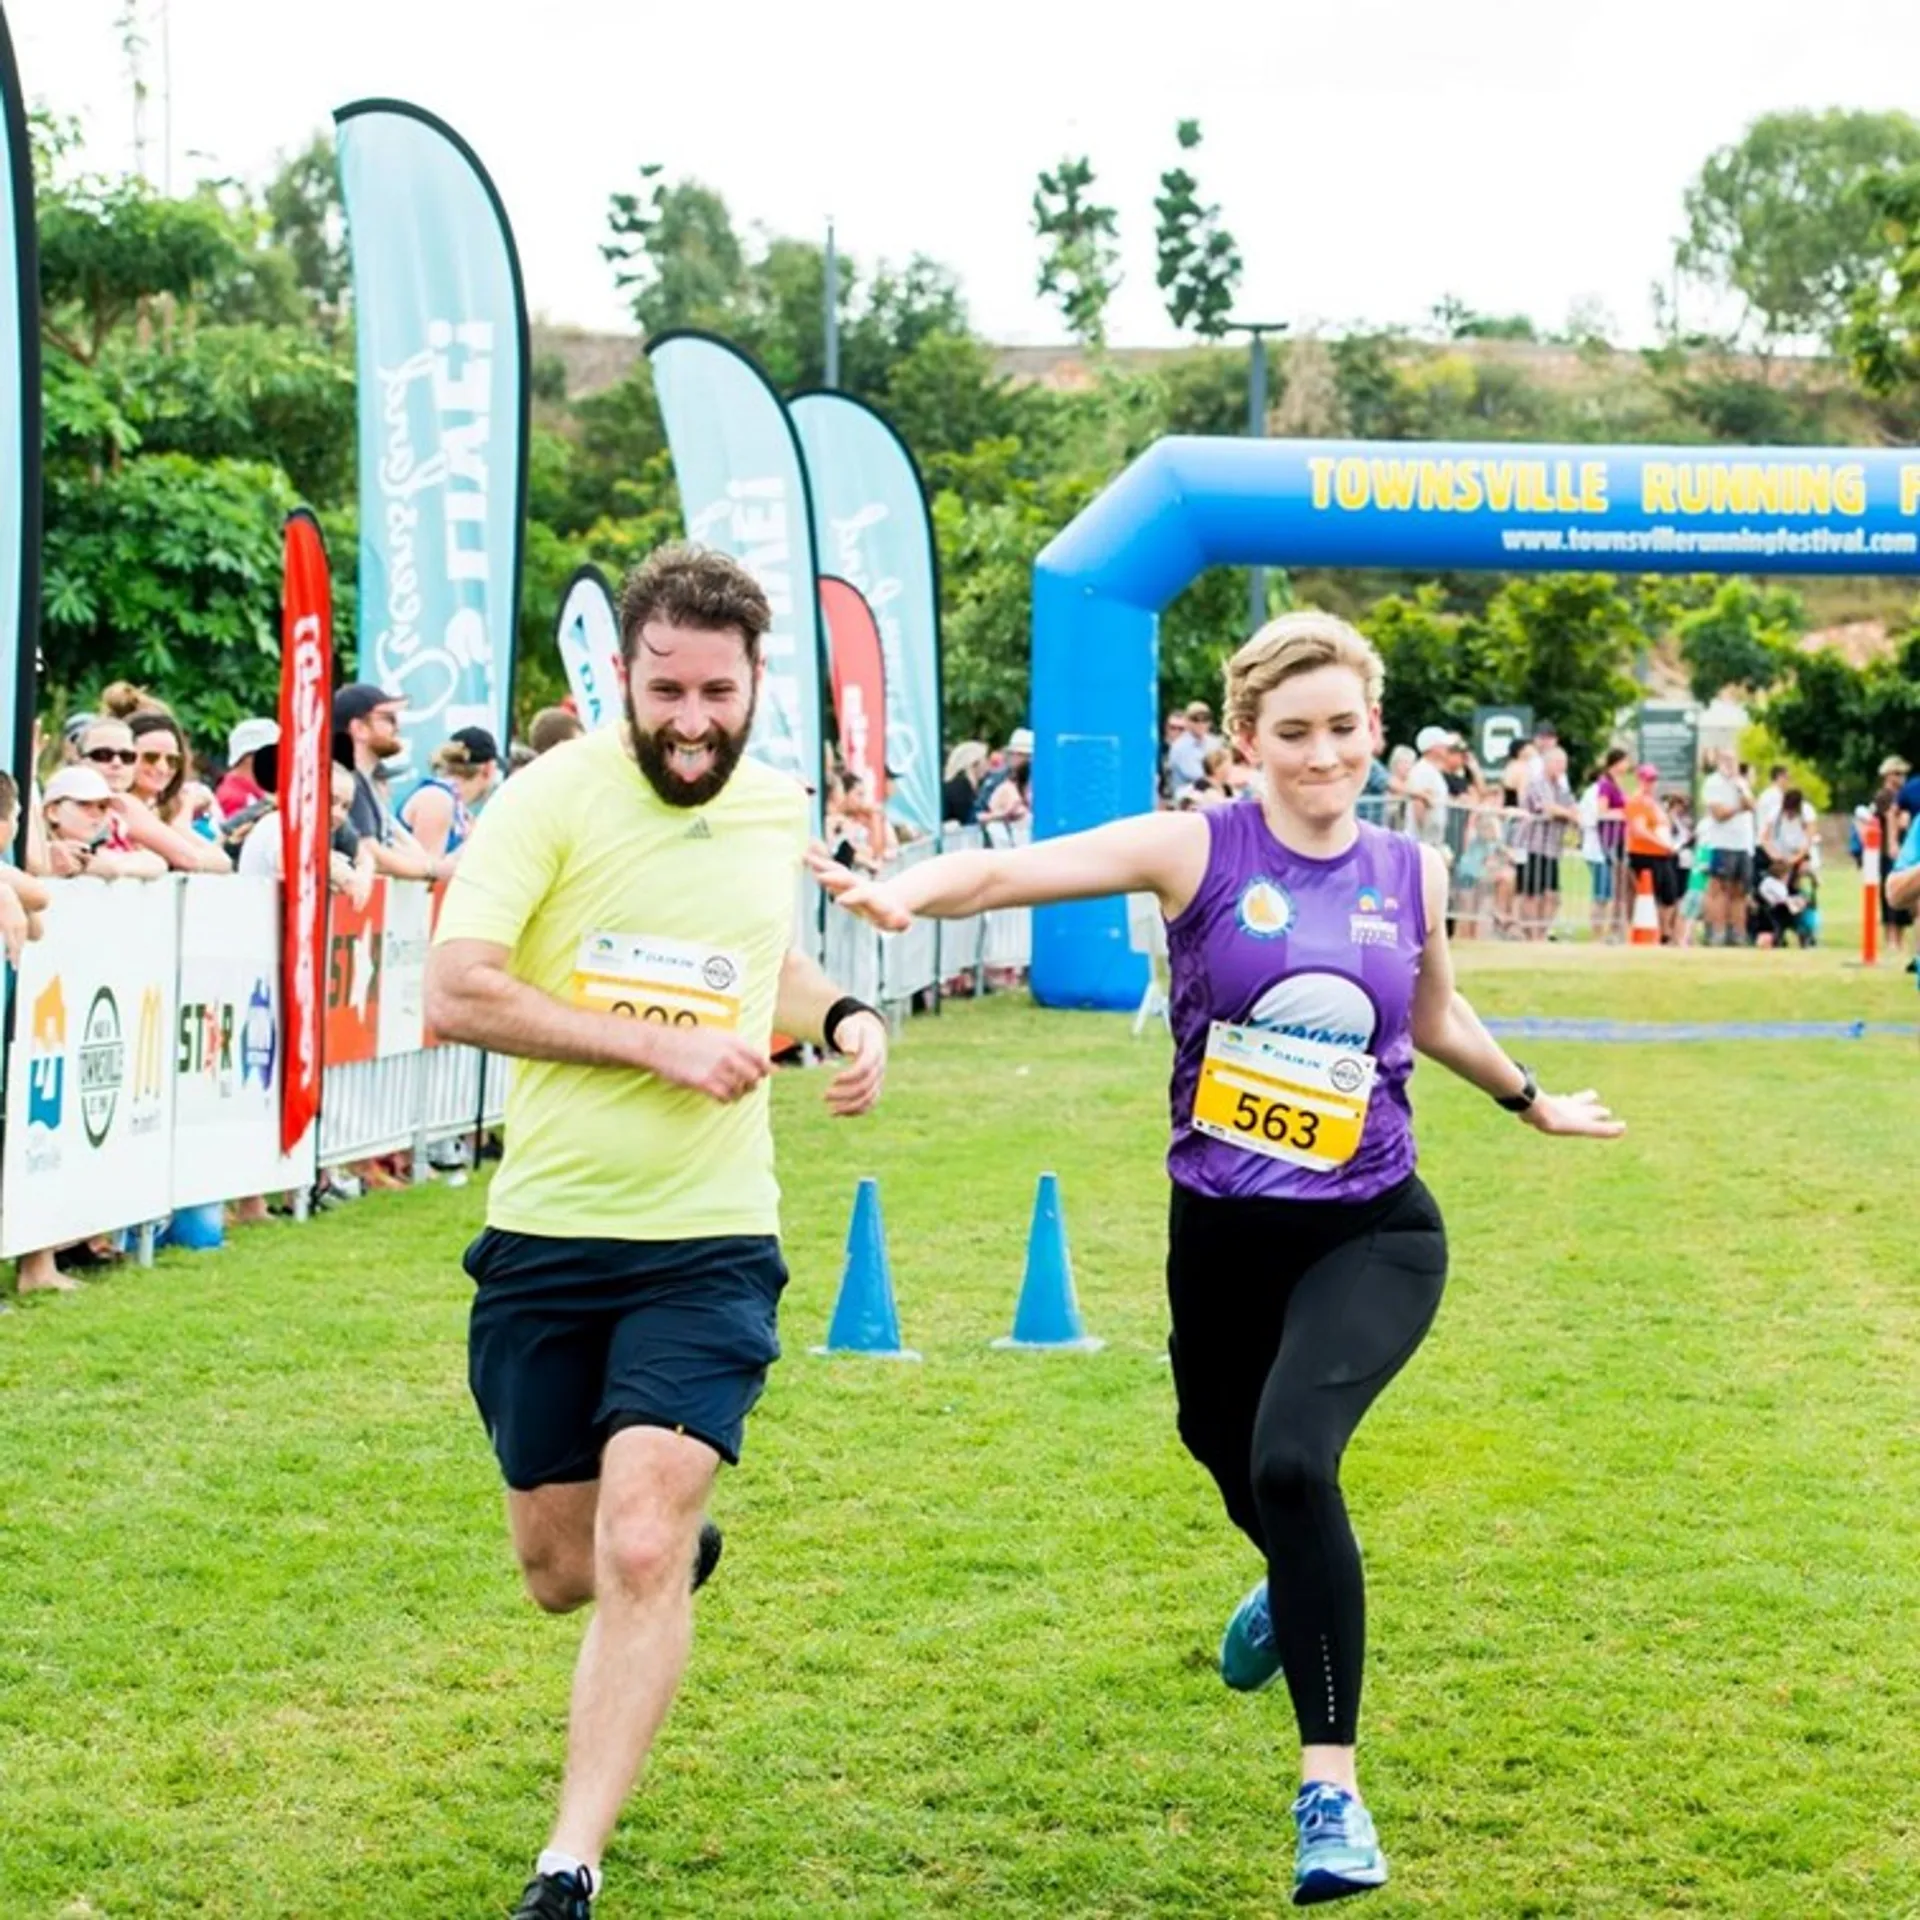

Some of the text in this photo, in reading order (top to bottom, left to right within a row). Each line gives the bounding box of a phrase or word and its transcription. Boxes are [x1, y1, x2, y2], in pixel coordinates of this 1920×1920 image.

[1308, 457, 1608, 513] TOWNSVILLE
[1642, 462, 1866, 515] RUNNING
[1233, 1092, 1319, 1149] 563
